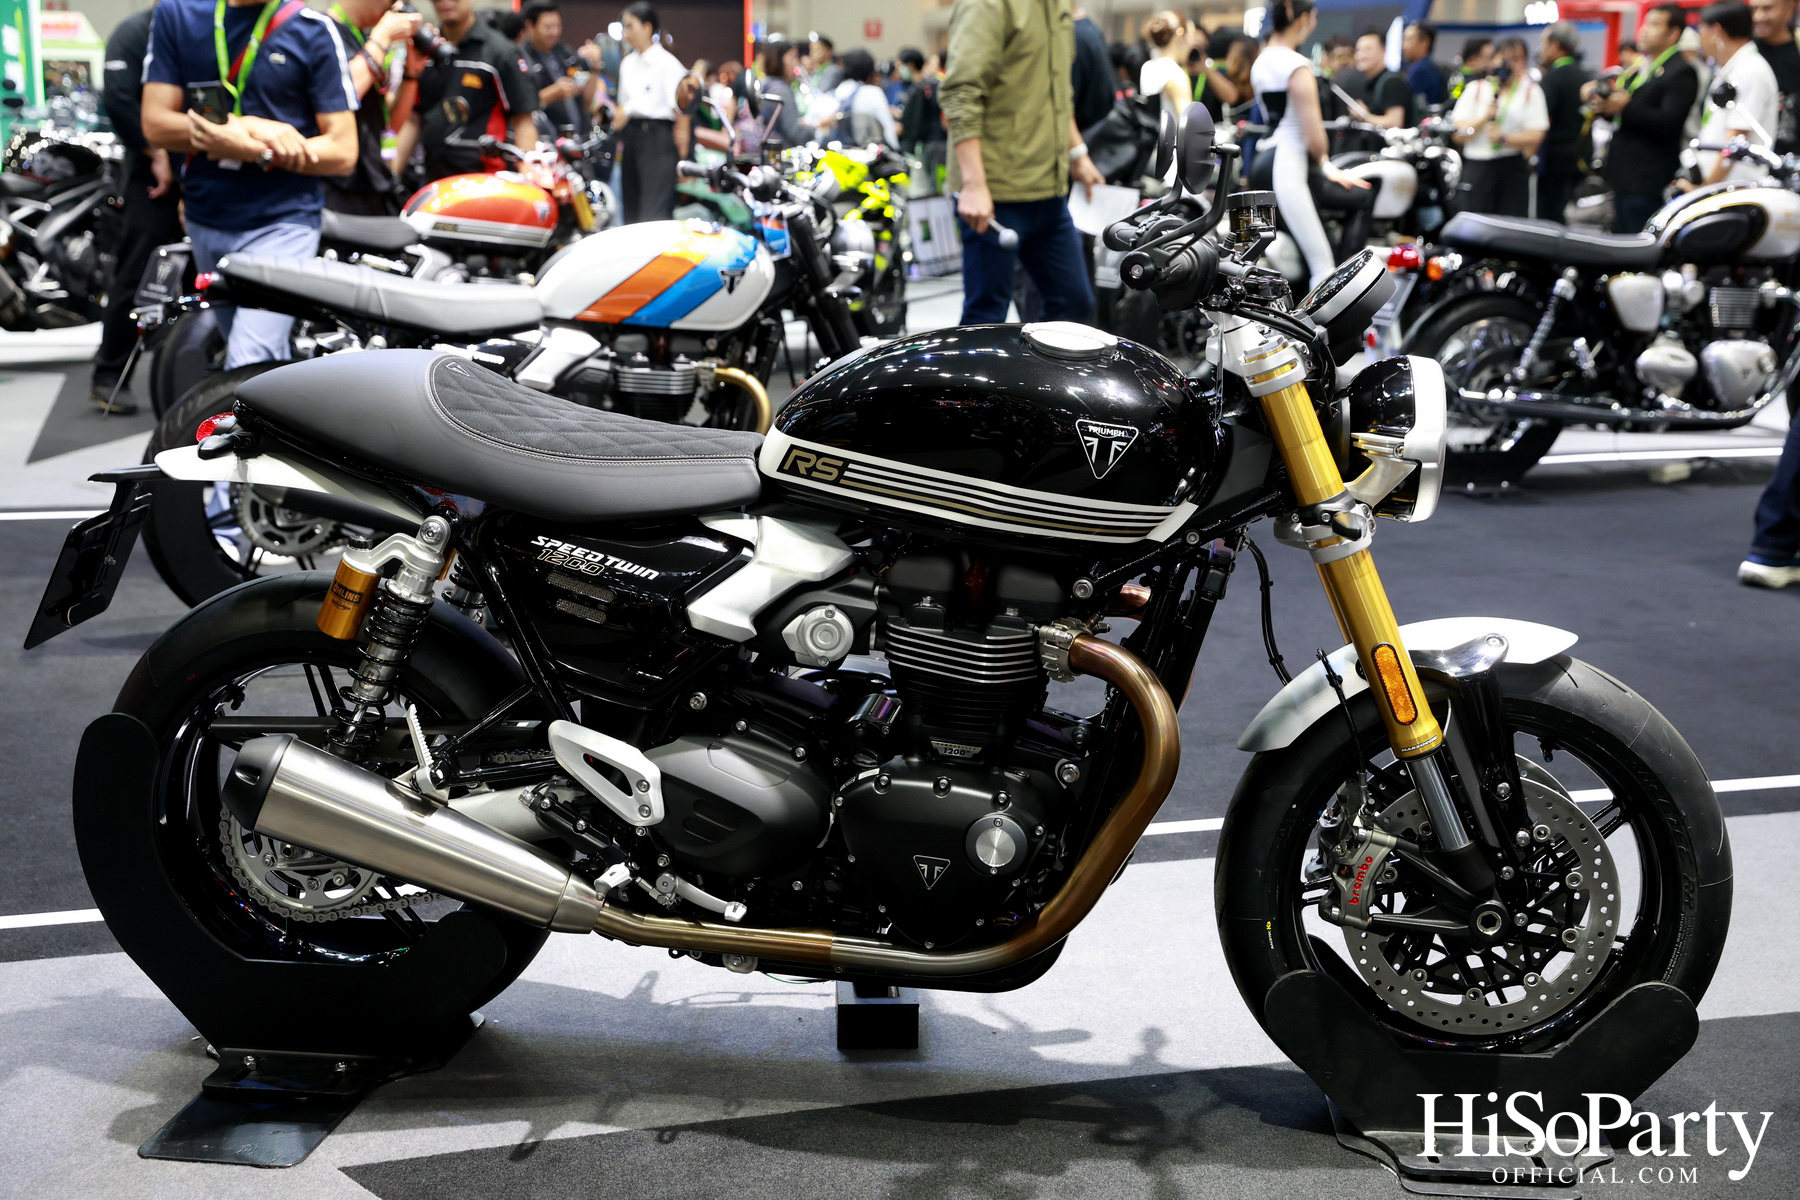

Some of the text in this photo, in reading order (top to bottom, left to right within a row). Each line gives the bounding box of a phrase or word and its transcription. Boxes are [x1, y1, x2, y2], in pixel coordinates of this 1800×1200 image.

[1088, 425, 1125, 437] TRIUMPH
[783, 449, 844, 481] RS
[530, 535, 660, 581] SPEED TWIN
[537, 548, 605, 576] 1200
[1347, 856, 1373, 905] brembo
